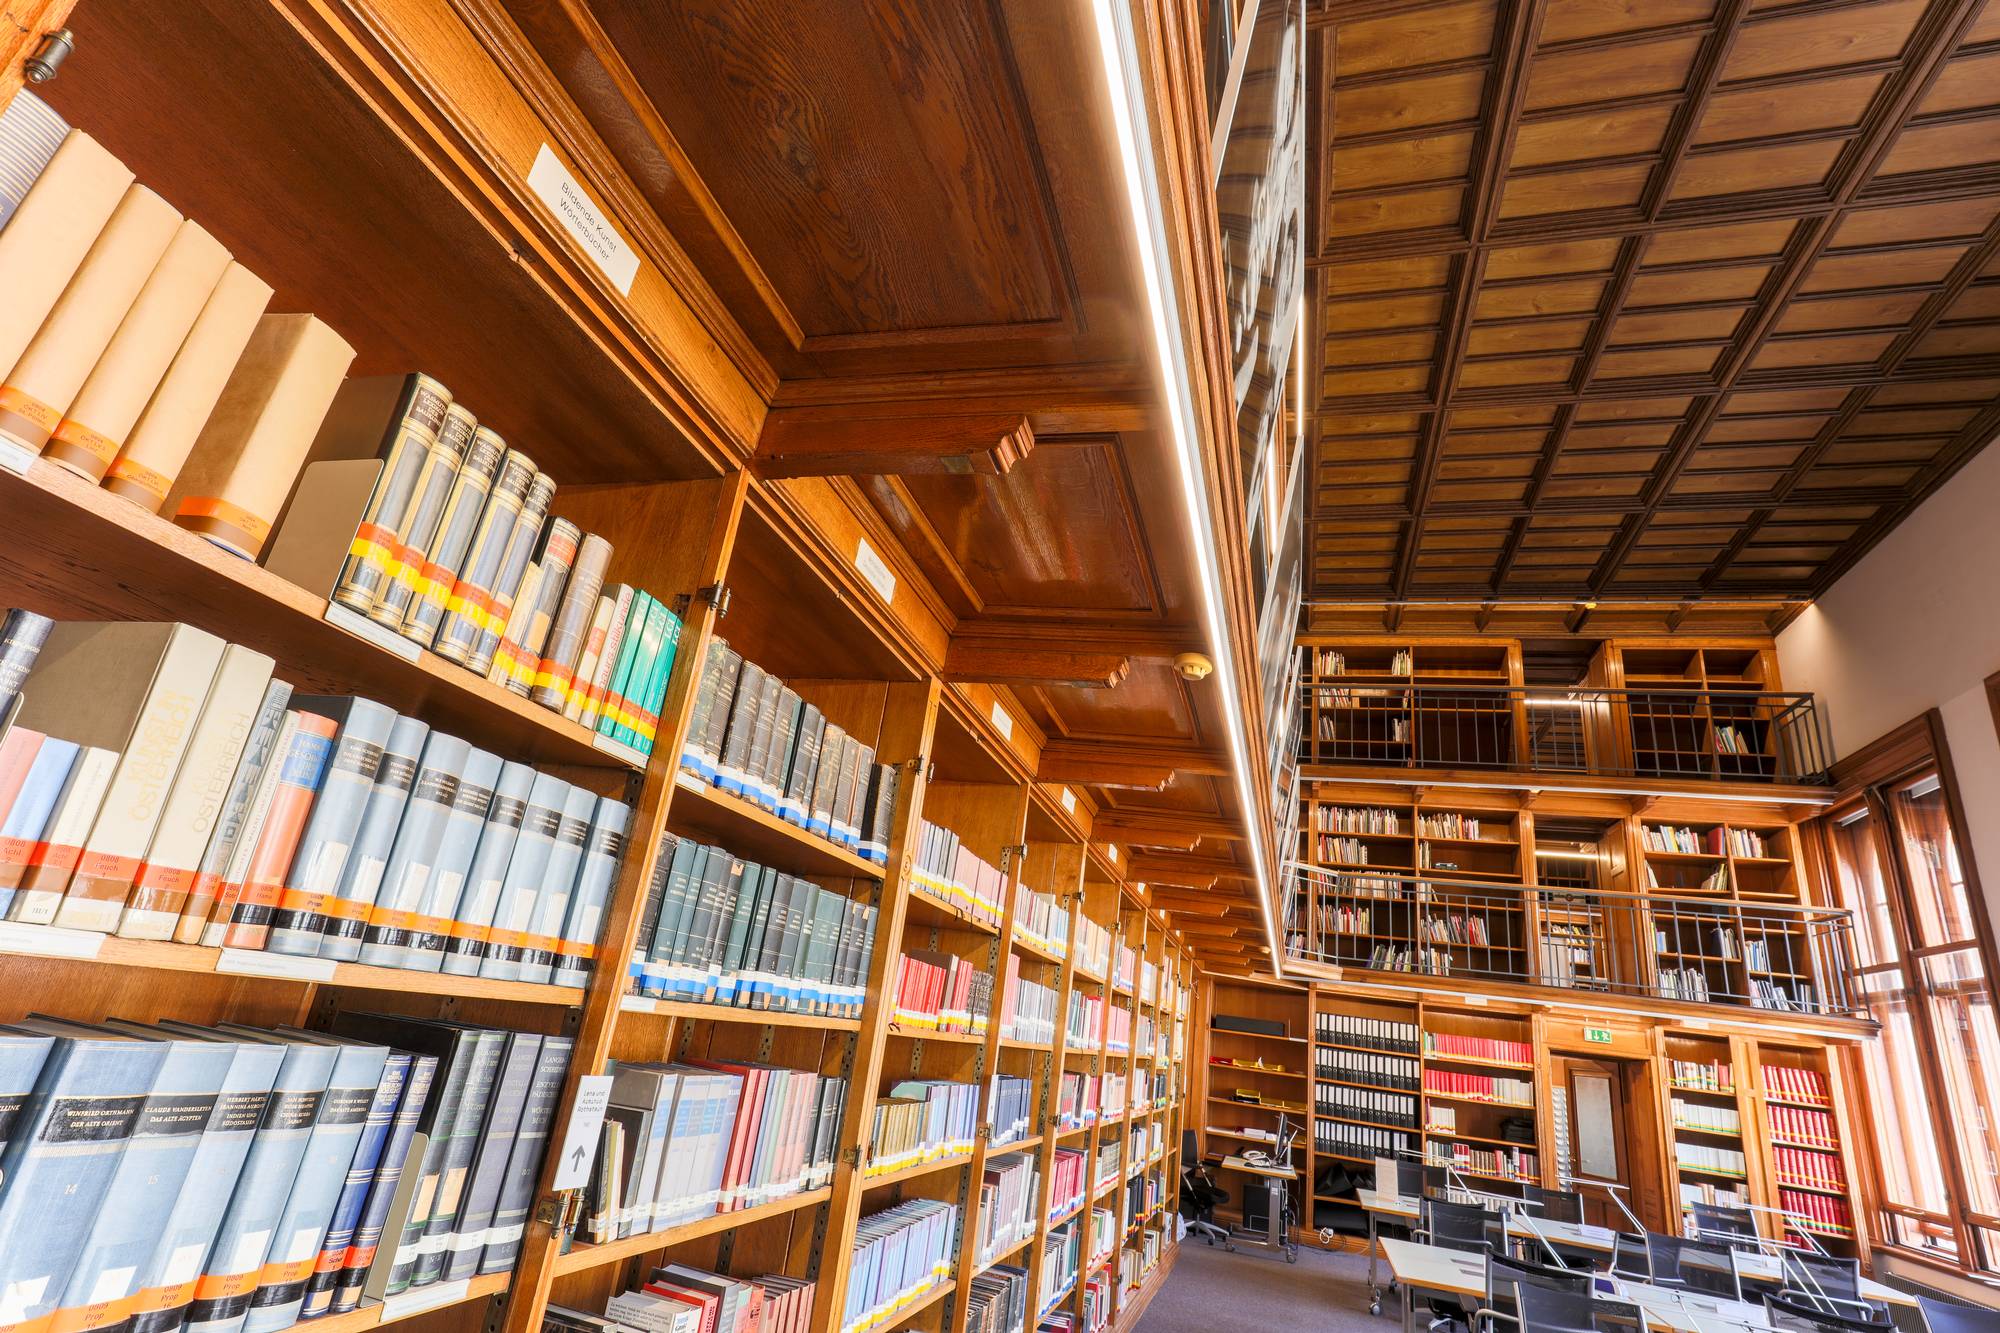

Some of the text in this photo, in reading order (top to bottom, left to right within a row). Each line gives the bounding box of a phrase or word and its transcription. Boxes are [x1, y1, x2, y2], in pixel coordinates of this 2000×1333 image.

[561, 181, 618, 253] Bildende Kunst
[559, 198, 610, 261] Wörterbücher
[95, 862, 119, 872] Feuch
[67, 1109, 100, 1117] WINFRIED
[70, 1119, 124, 1128] DER ALTE ORIENT
[164, 1284, 183, 1293] 0809
[223, 1282, 240, 1291] Prop
[161, 1294, 179, 1302] Prop
[88, 1302, 109, 1312] 0809
[84, 1312, 105, 1321] Prop
